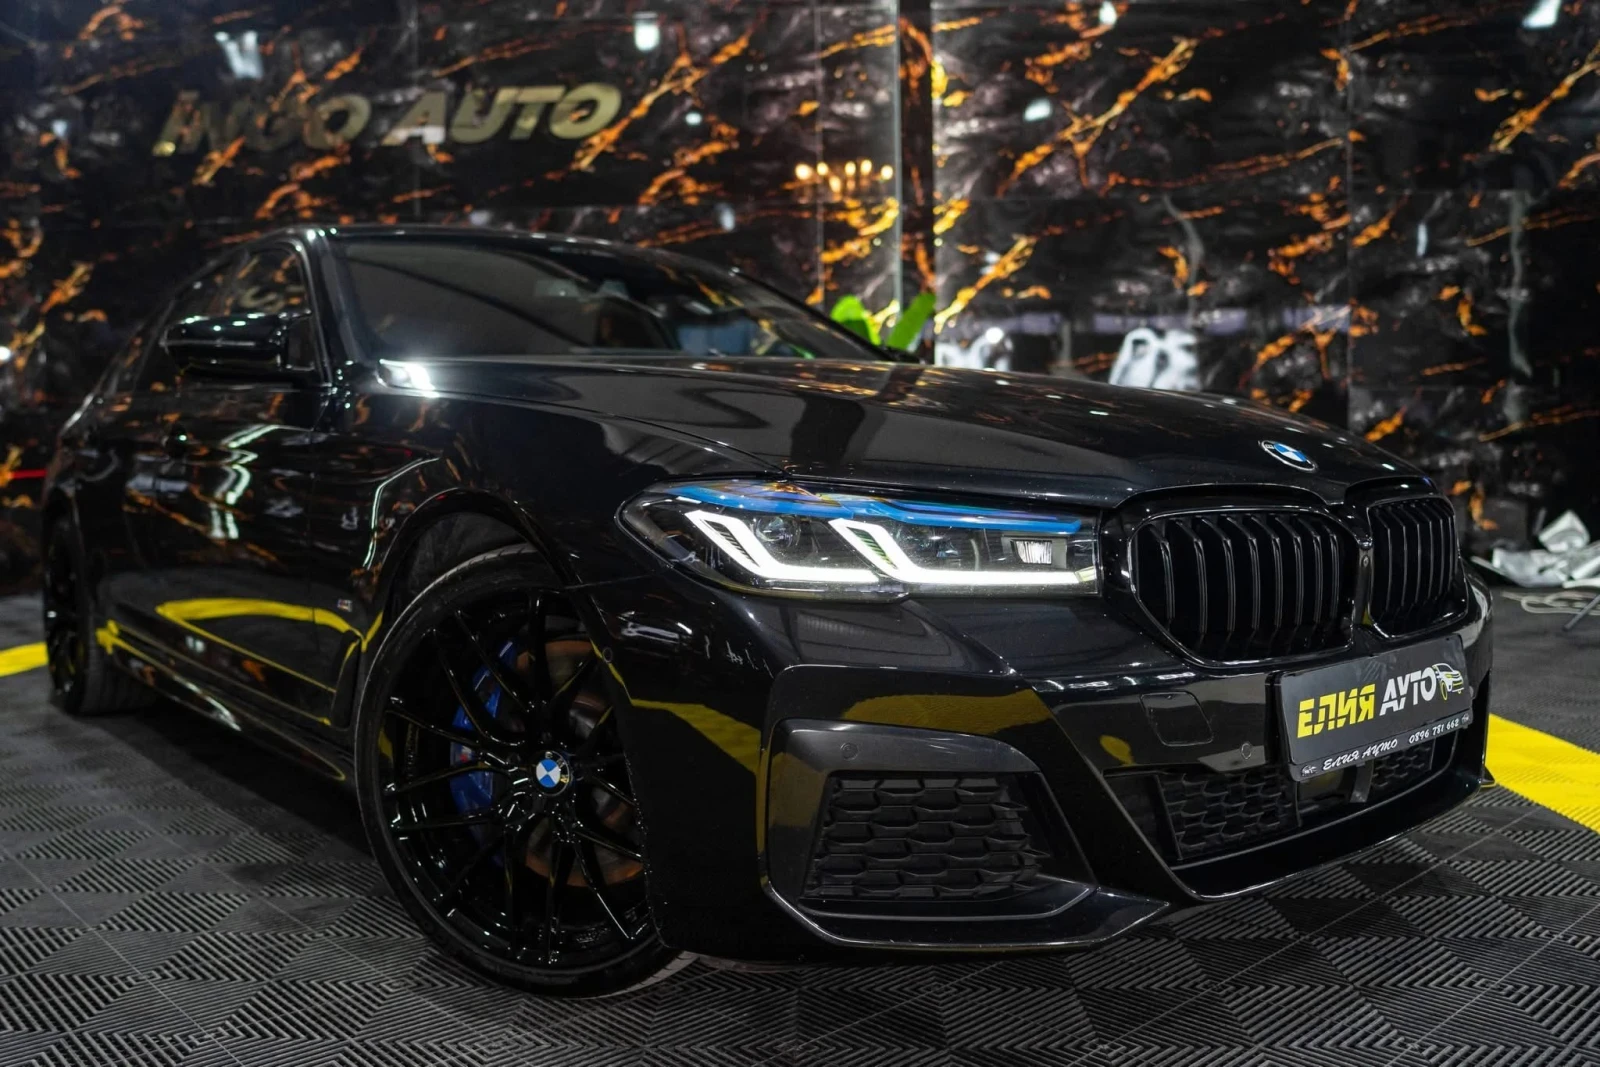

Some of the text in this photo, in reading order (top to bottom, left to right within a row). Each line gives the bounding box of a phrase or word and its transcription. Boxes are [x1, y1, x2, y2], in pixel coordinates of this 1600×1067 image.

[381, 82, 622, 147] AUTO
[1297, 666, 1437, 739] ЕЛИЯ АУТО
[1408, 729, 1430, 744] 0896
[1432, 723, 1445, 736] 781
[1446, 718, 1460, 730] 662
